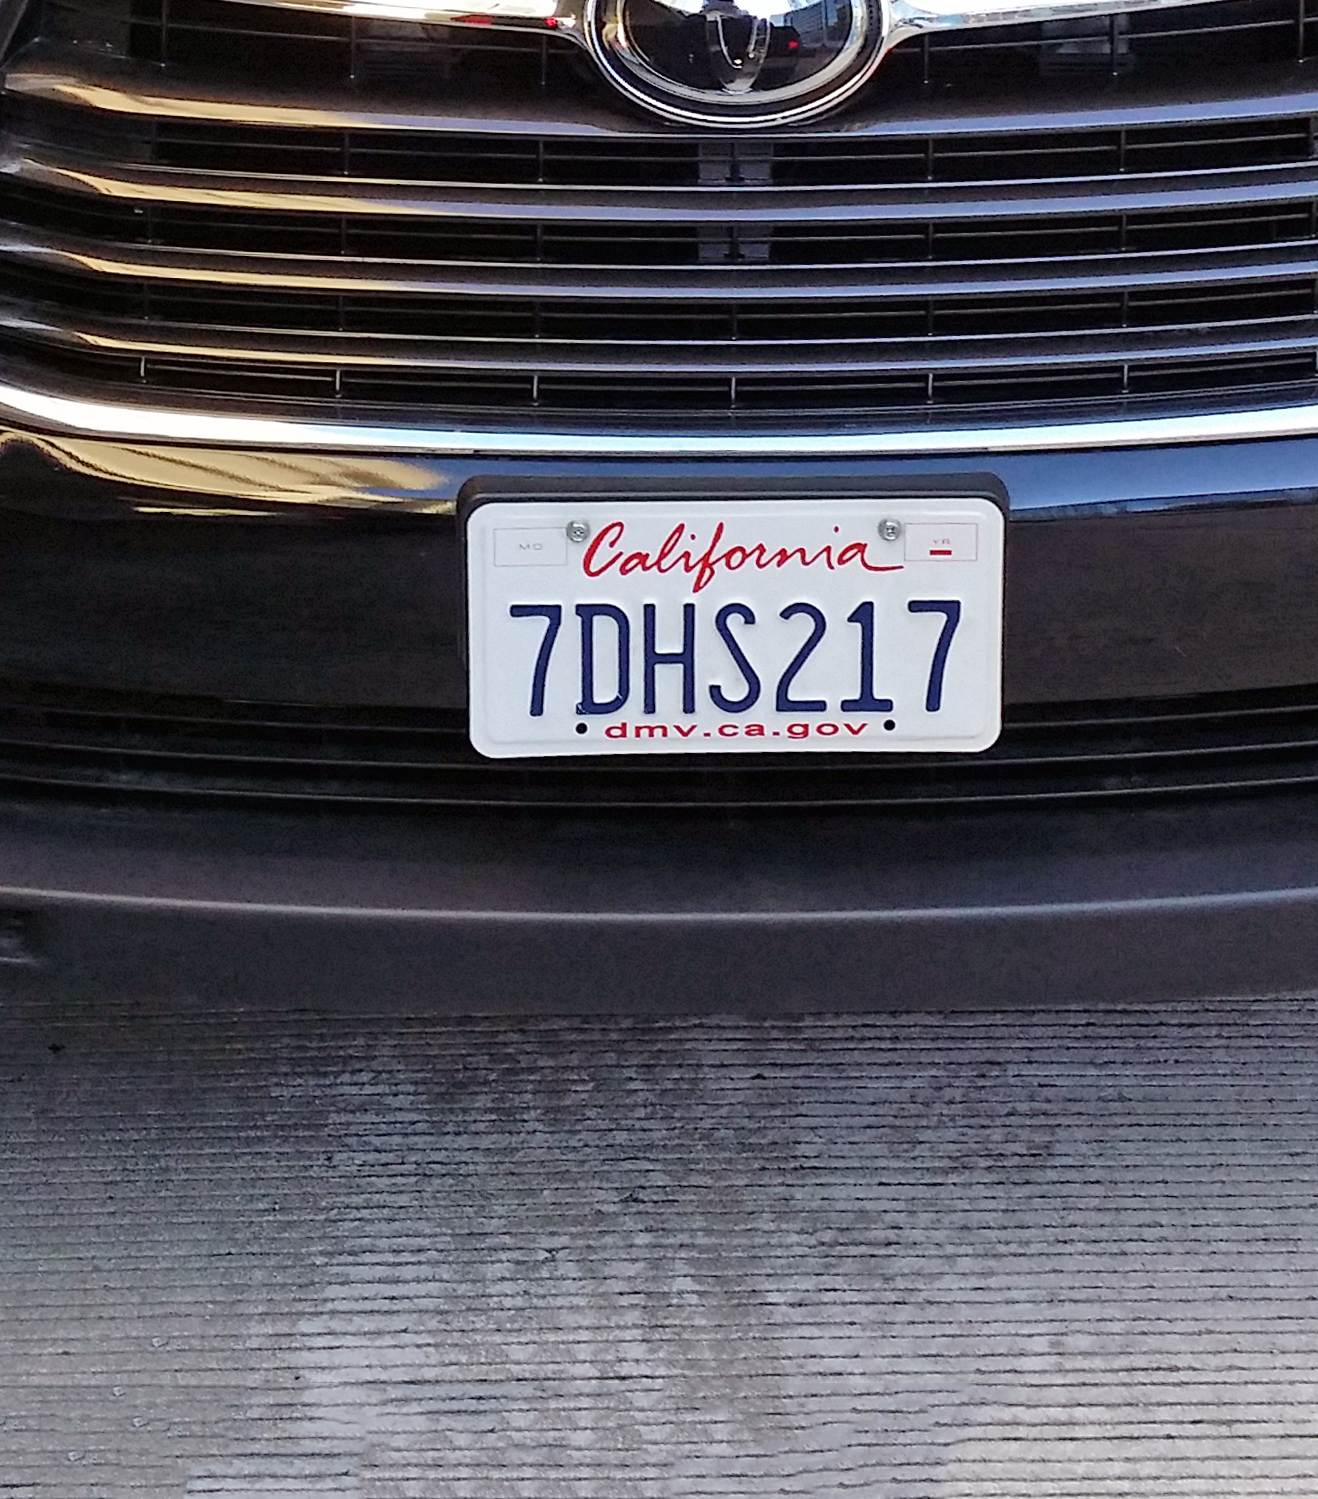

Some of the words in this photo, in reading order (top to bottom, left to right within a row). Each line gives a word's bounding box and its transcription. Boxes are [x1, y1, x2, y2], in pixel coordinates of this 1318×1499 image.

[518, 542, 543, 551] MO
[582, 520, 904, 594] California
[509, 599, 962, 717] 7DHS217
[604, 721, 868, 740] dmv.ca.gov
